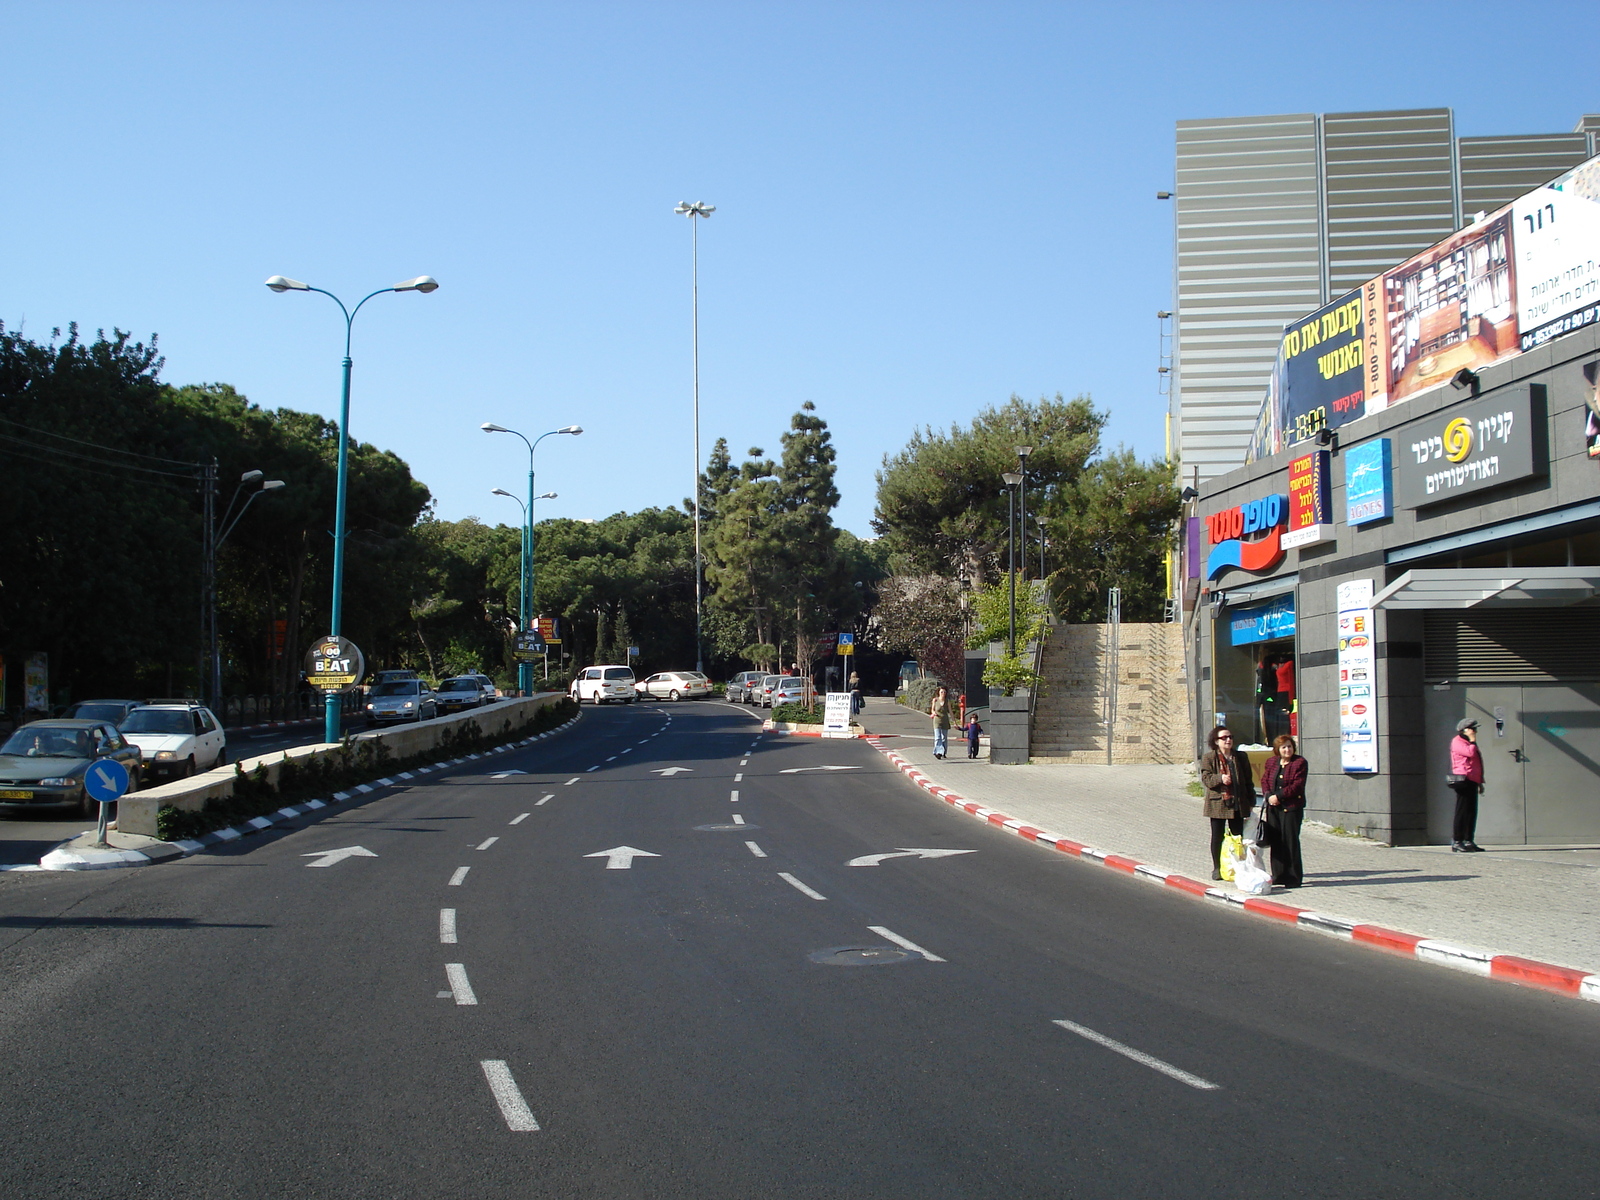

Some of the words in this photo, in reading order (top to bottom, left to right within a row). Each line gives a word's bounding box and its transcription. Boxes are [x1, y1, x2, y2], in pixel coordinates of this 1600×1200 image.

[1531, 276, 1560, 298] ארונות
[1322, 297, 1362, 342] קובעת
[1528, 302, 1549, 320] שינה
[1572, 313, 1583, 328] 90
[1301, 318, 1321, 353] את
[1368, 282, 1379, 396] 1-800-22-99-06
[1318, 338, 1364, 380] האנושי
[1478, 411, 1513, 452] קניון
[1411, 435, 1443, 464] כיכר
[1294, 457, 1312, 474] המרכז
[1426, 456, 1499, 494] האודיטוריום
[1299, 490, 1313, 508] לרגל
[1300, 508, 1314, 526] ולגב
[1350, 500, 1382, 520] AGNES
[518, 642, 541, 651] BEAT
[316, 658, 350, 672] BEAT
